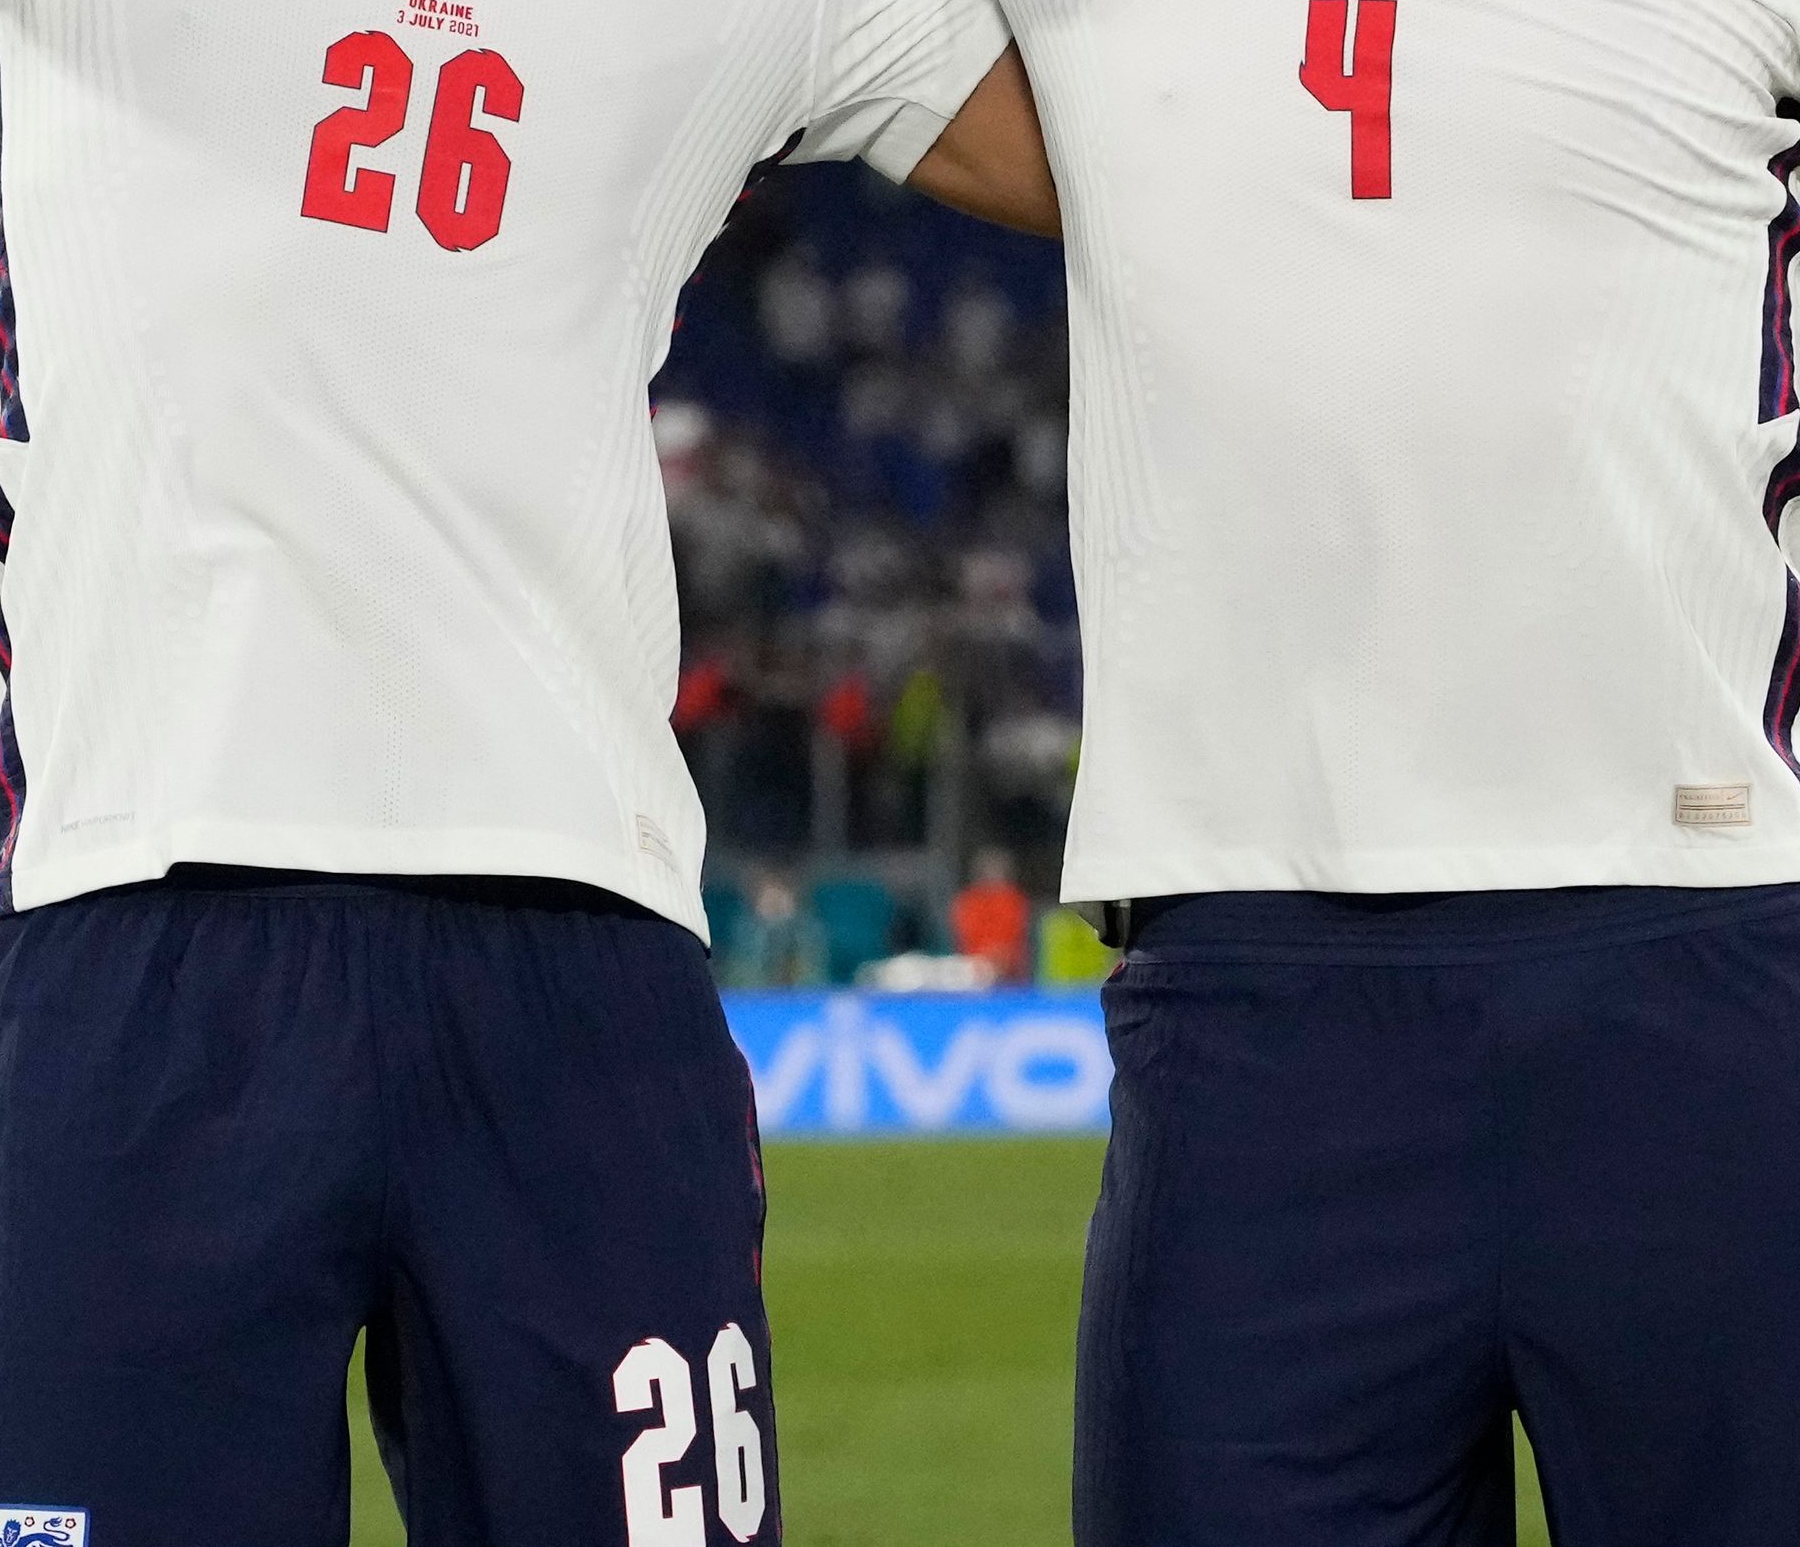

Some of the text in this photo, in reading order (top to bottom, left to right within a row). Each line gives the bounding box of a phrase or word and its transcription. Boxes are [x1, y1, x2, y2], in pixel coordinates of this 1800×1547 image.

[396, 9, 480, 38] 3 JULY 2021
[300, 29, 525, 253] 26
[611, 1321, 766, 1547] 26
